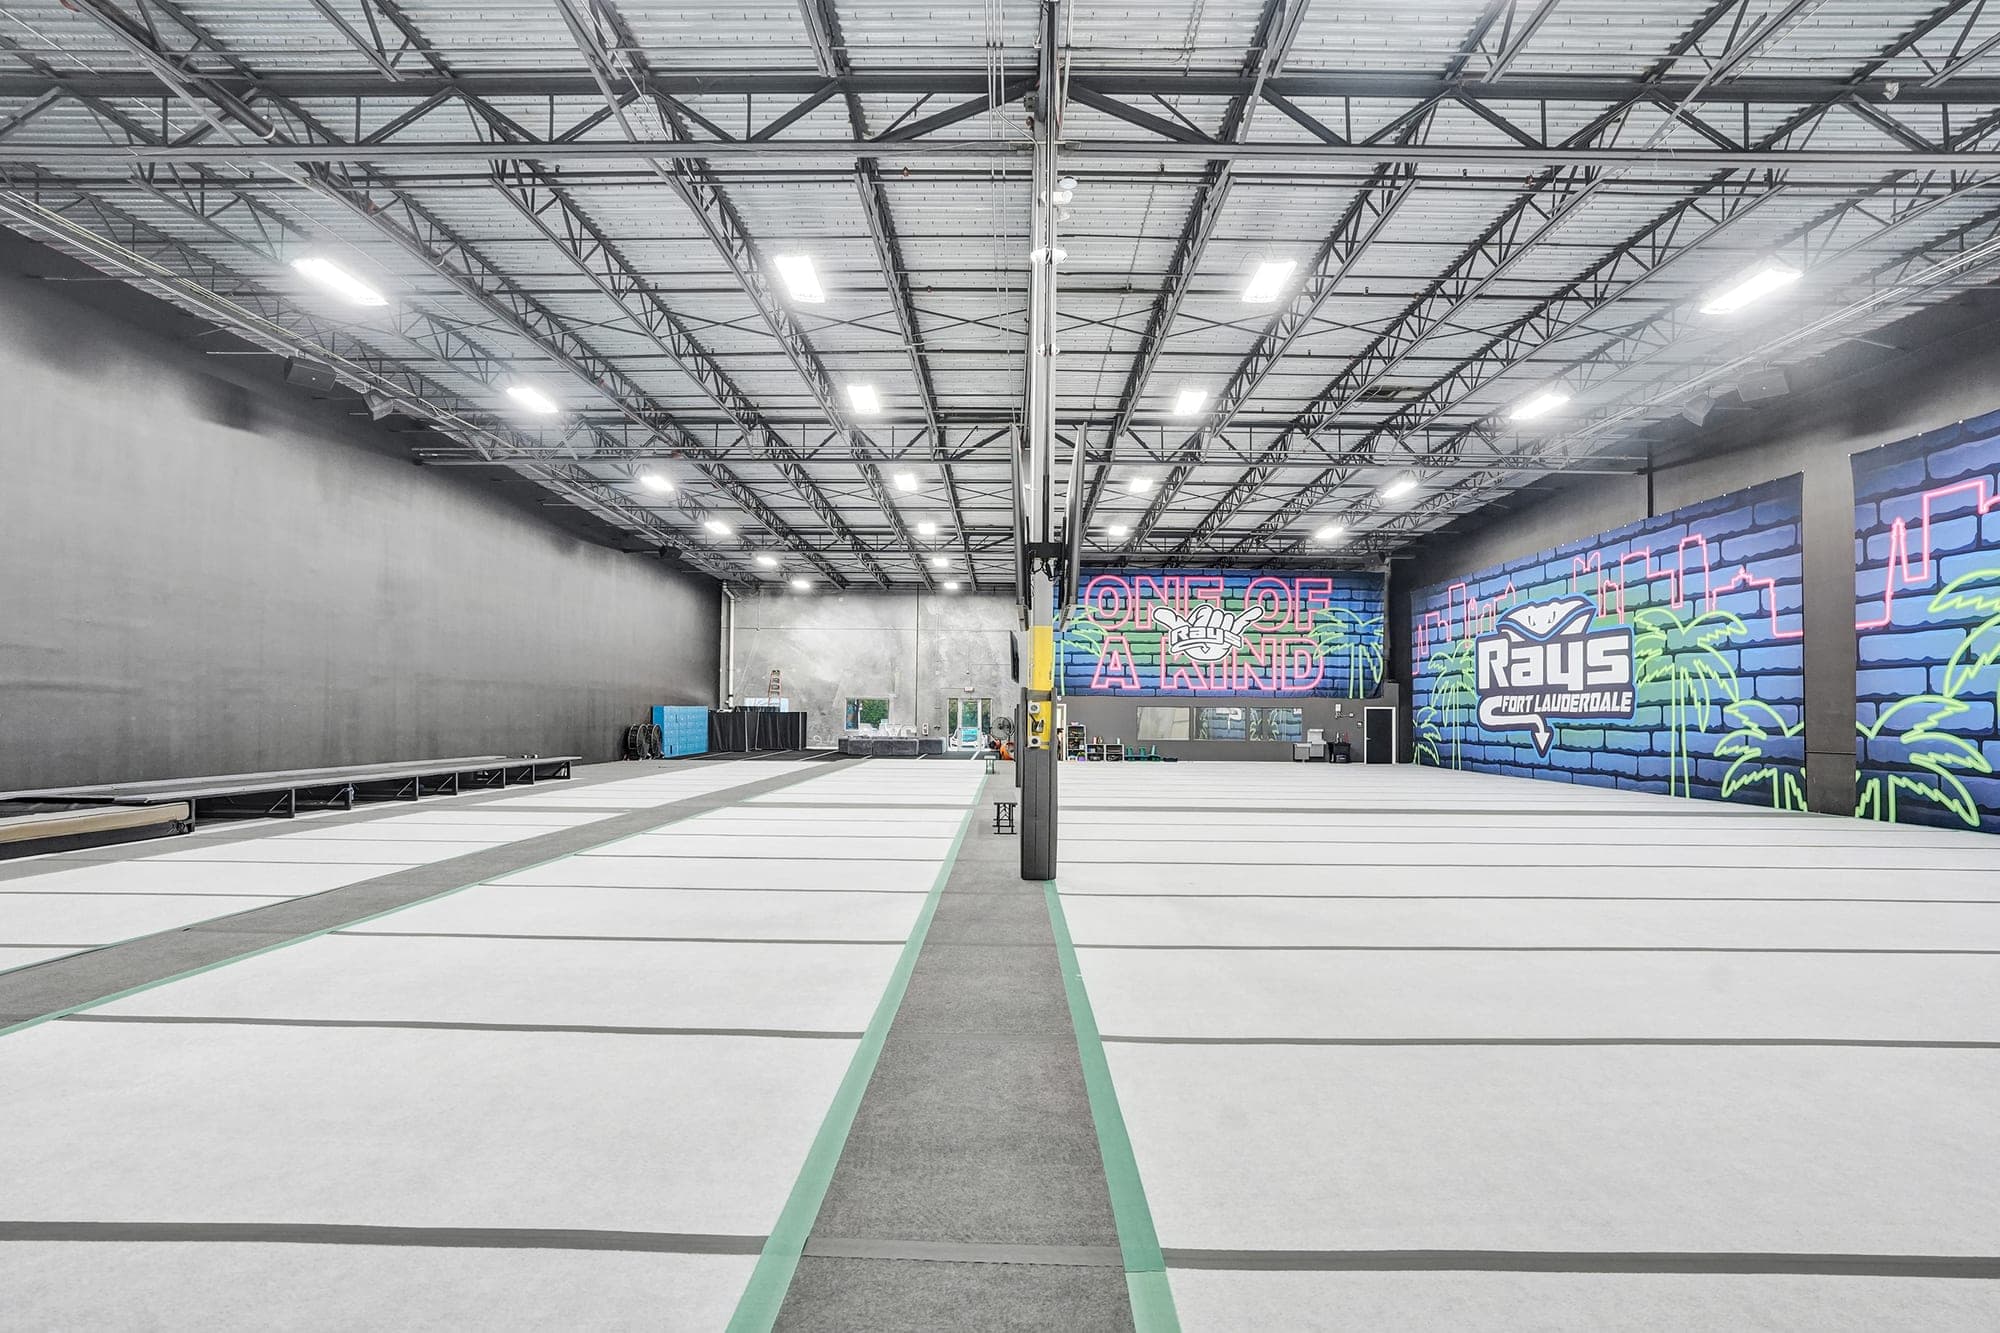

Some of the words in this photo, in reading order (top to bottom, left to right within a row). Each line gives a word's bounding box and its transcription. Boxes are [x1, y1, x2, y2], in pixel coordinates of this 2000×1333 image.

[1085, 575, 1224, 631] ONE
[1244, 576, 1333, 632] OF
[1091, 636, 1140, 690] A
[1160, 636, 1325, 691] KIND
[1170, 625, 1243, 649] Rays
[1478, 635, 1629, 691] Rays
[1501, 695, 1533, 713] FORT
[1533, 691, 1632, 713] LAUDERDALE
